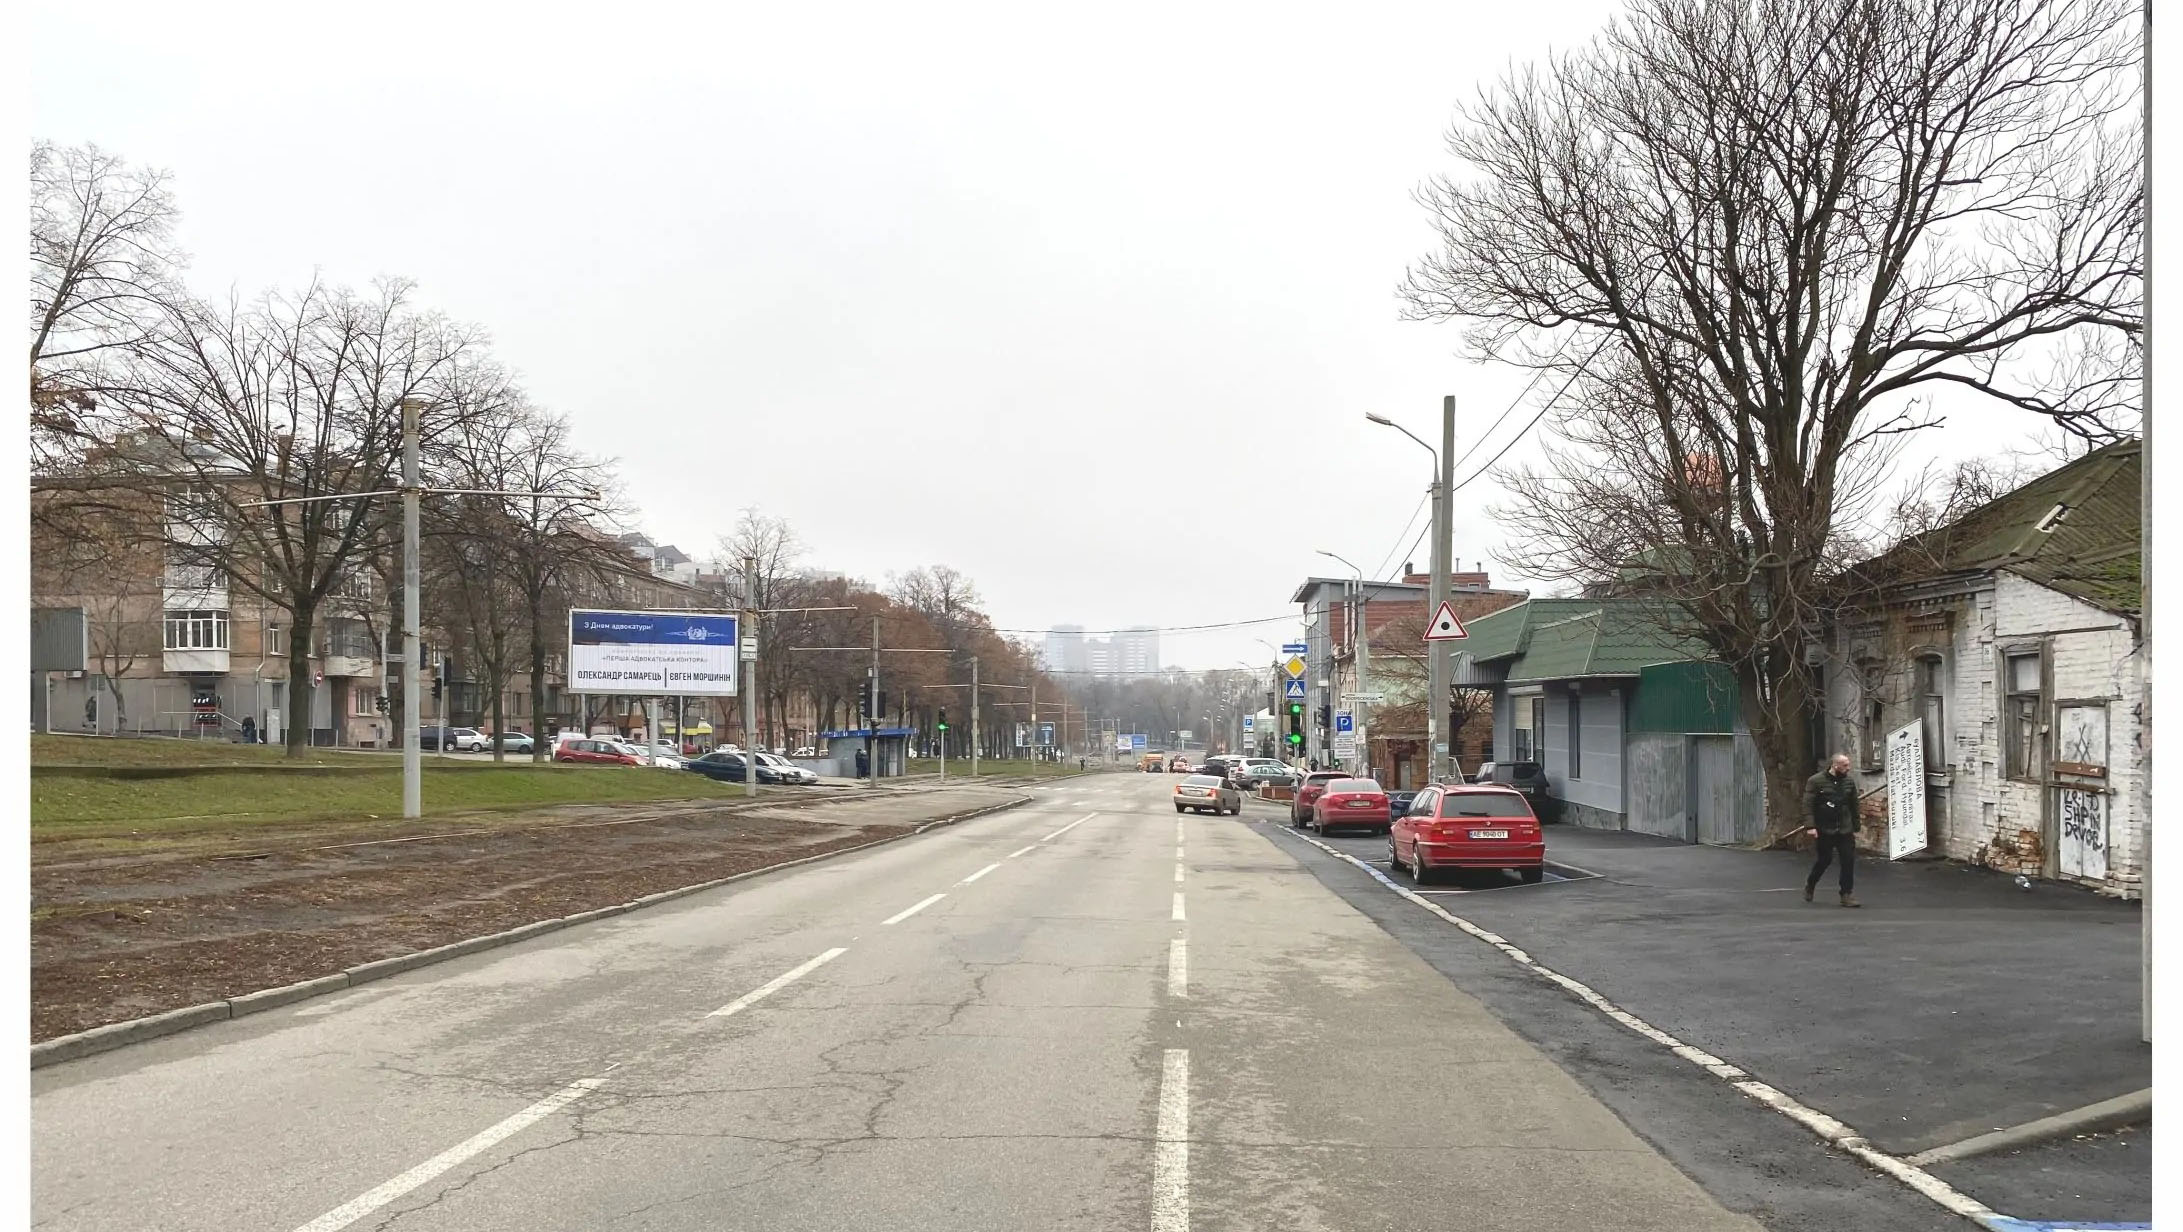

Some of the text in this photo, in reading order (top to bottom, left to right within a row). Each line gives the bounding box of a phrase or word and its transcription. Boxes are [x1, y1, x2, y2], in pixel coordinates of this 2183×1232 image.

[584, 621, 654, 632] З Днем адвокатури!
[629, 655, 675, 663] АДВОКАТСЬКА
[577, 670, 662, 682] ОЛЕКСАНДР САМАРЕЦЬ
[669, 672, 731, 682] ЄВГЕН МОРШИНІН
